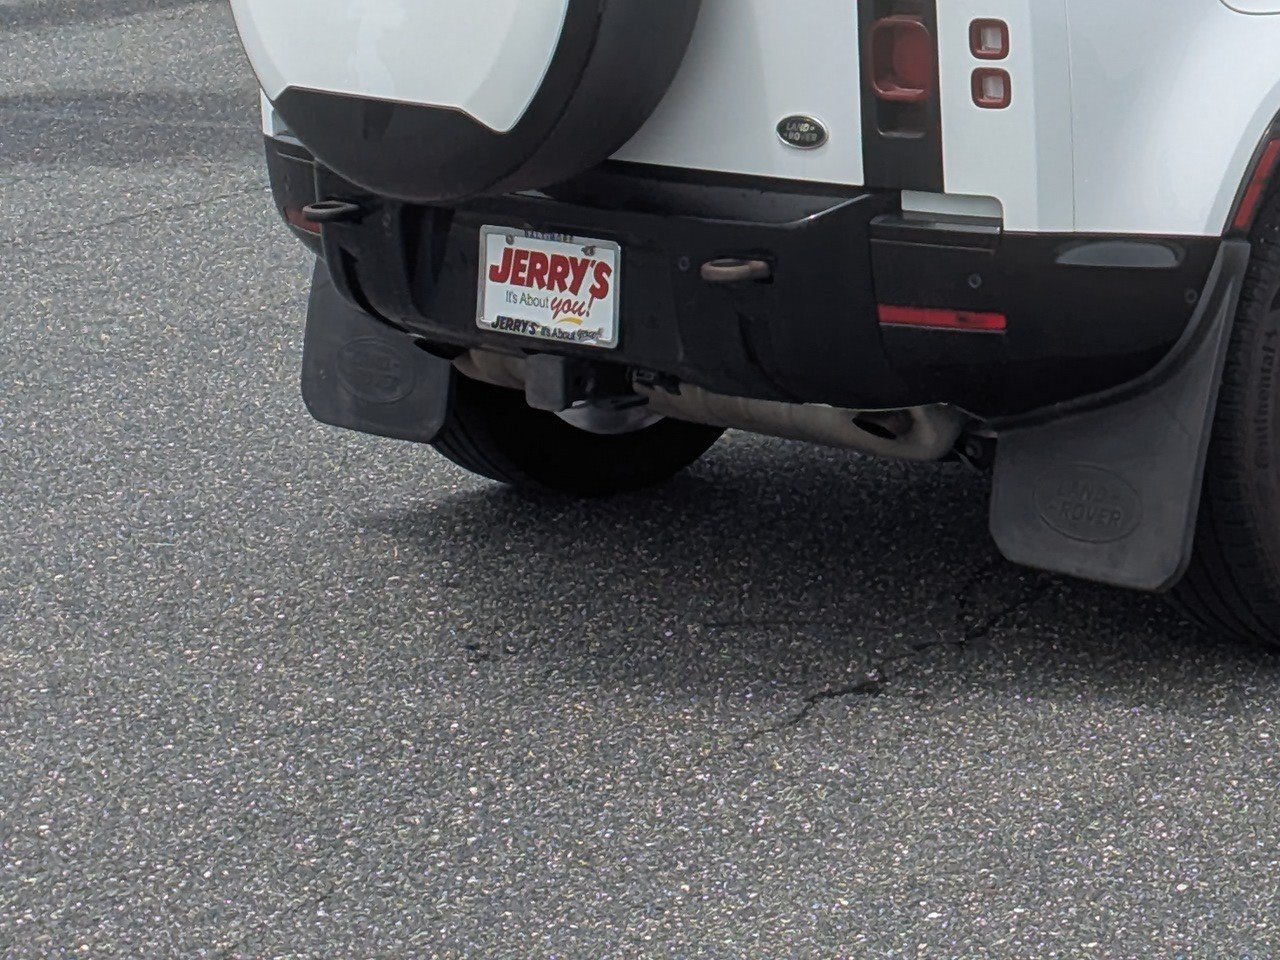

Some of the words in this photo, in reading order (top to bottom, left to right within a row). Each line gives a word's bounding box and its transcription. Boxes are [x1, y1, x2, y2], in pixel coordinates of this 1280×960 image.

[786, 123, 810, 132] LAND
[489, 247, 612, 300] JERRY'S
[506, 290, 518, 304] It's
[519, 292, 549, 309] About
[551, 291, 595, 320] you!
[491, 315, 540, 336] JERRY'S
